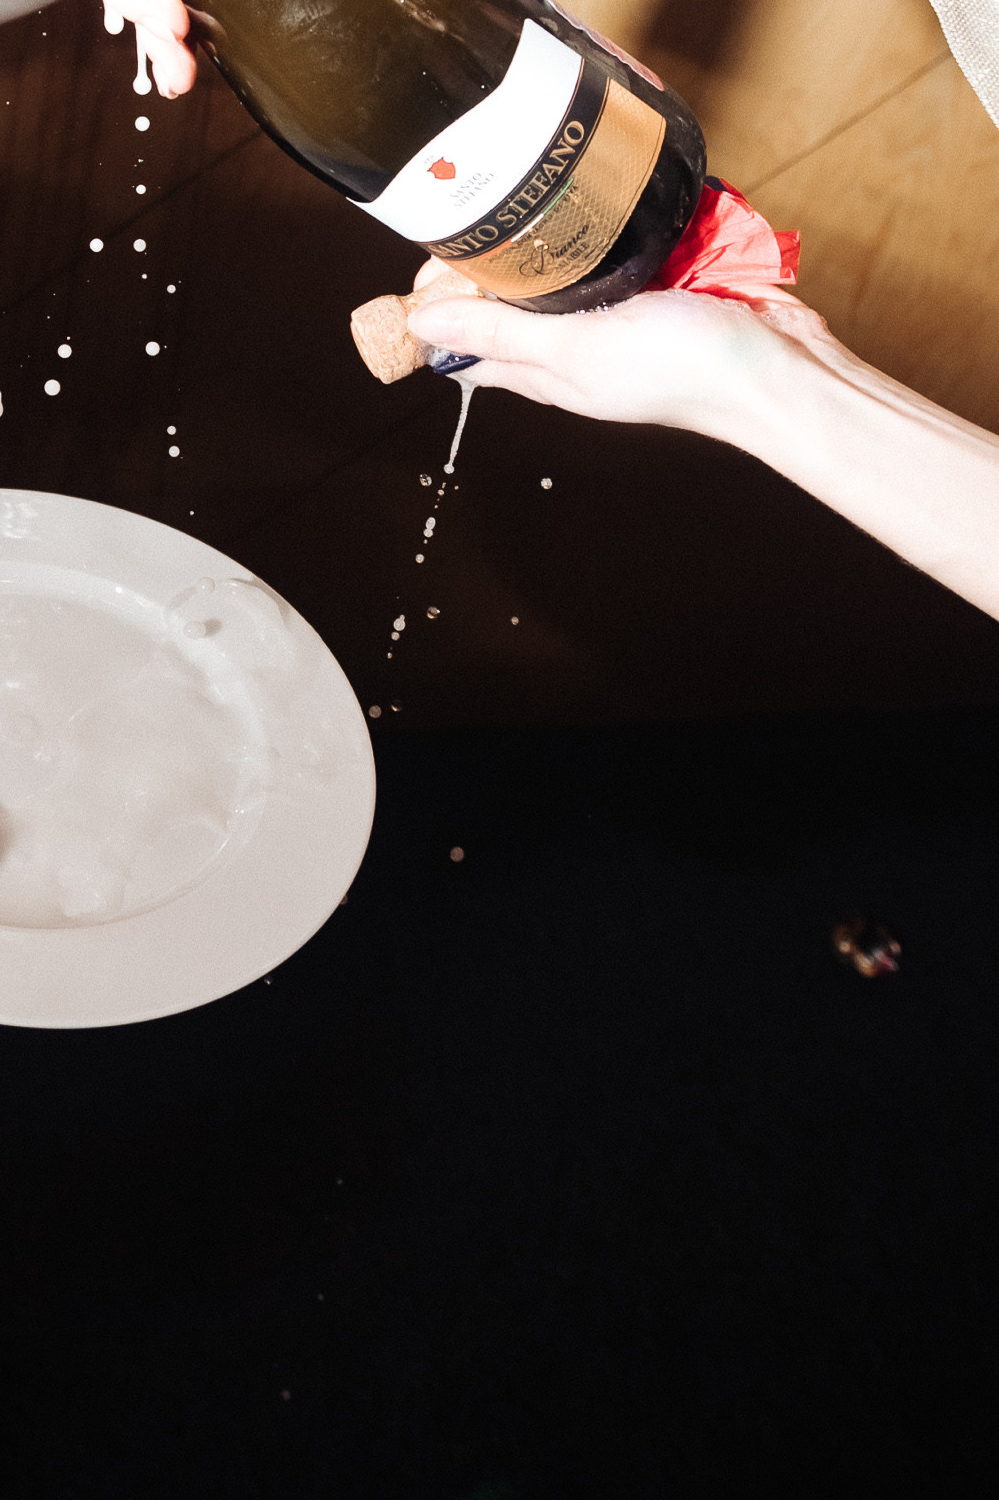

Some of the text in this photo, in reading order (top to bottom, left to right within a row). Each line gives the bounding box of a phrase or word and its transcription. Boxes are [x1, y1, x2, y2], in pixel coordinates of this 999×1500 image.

[428, 120, 585, 257] SANTO STEFANO
[450, 172, 482, 198] SANTO
[453, 172, 495, 208] STEFANO
